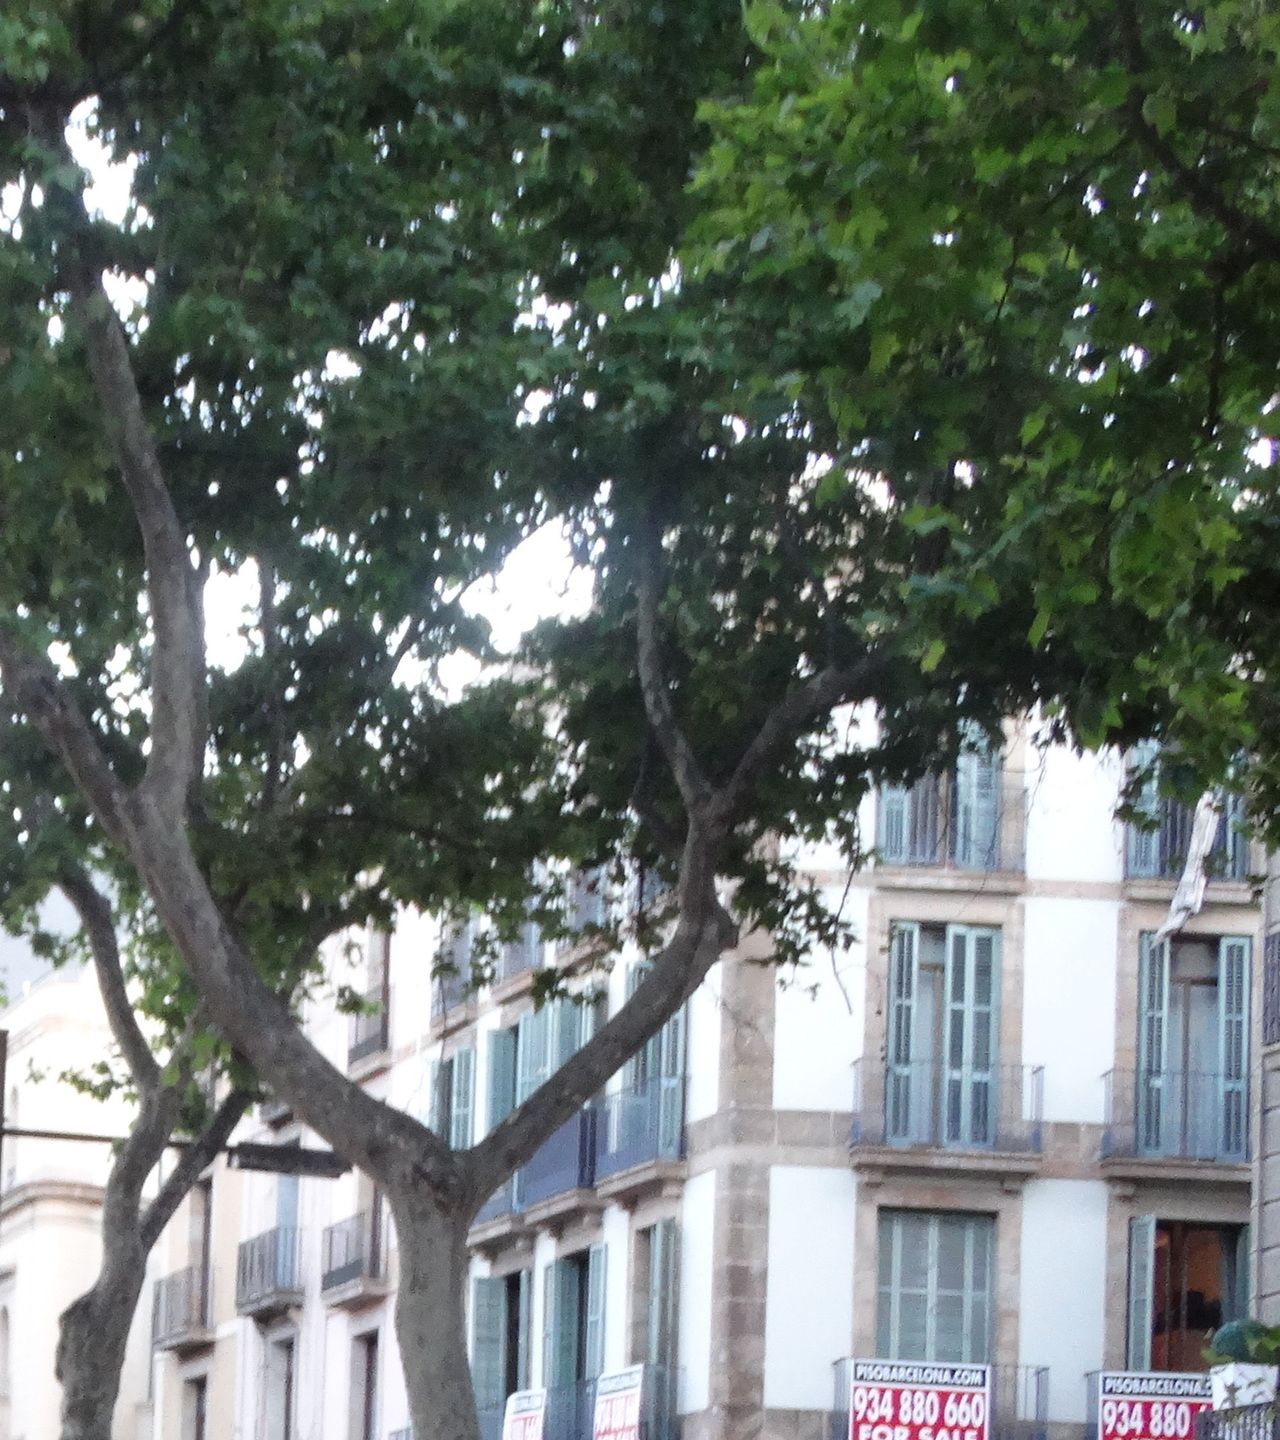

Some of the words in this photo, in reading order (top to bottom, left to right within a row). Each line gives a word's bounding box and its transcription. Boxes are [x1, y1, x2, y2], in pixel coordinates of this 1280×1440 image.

[856, 1364, 982, 1385] PISOBARCELONA.COM
[854, 1387, 894, 1423] 934
[899, 1389, 939, 1426] 880
[944, 1392, 985, 1429] 660
[1103, 1400, 1143, 1436] 934
[1149, 1402, 1190, 1438] 880
